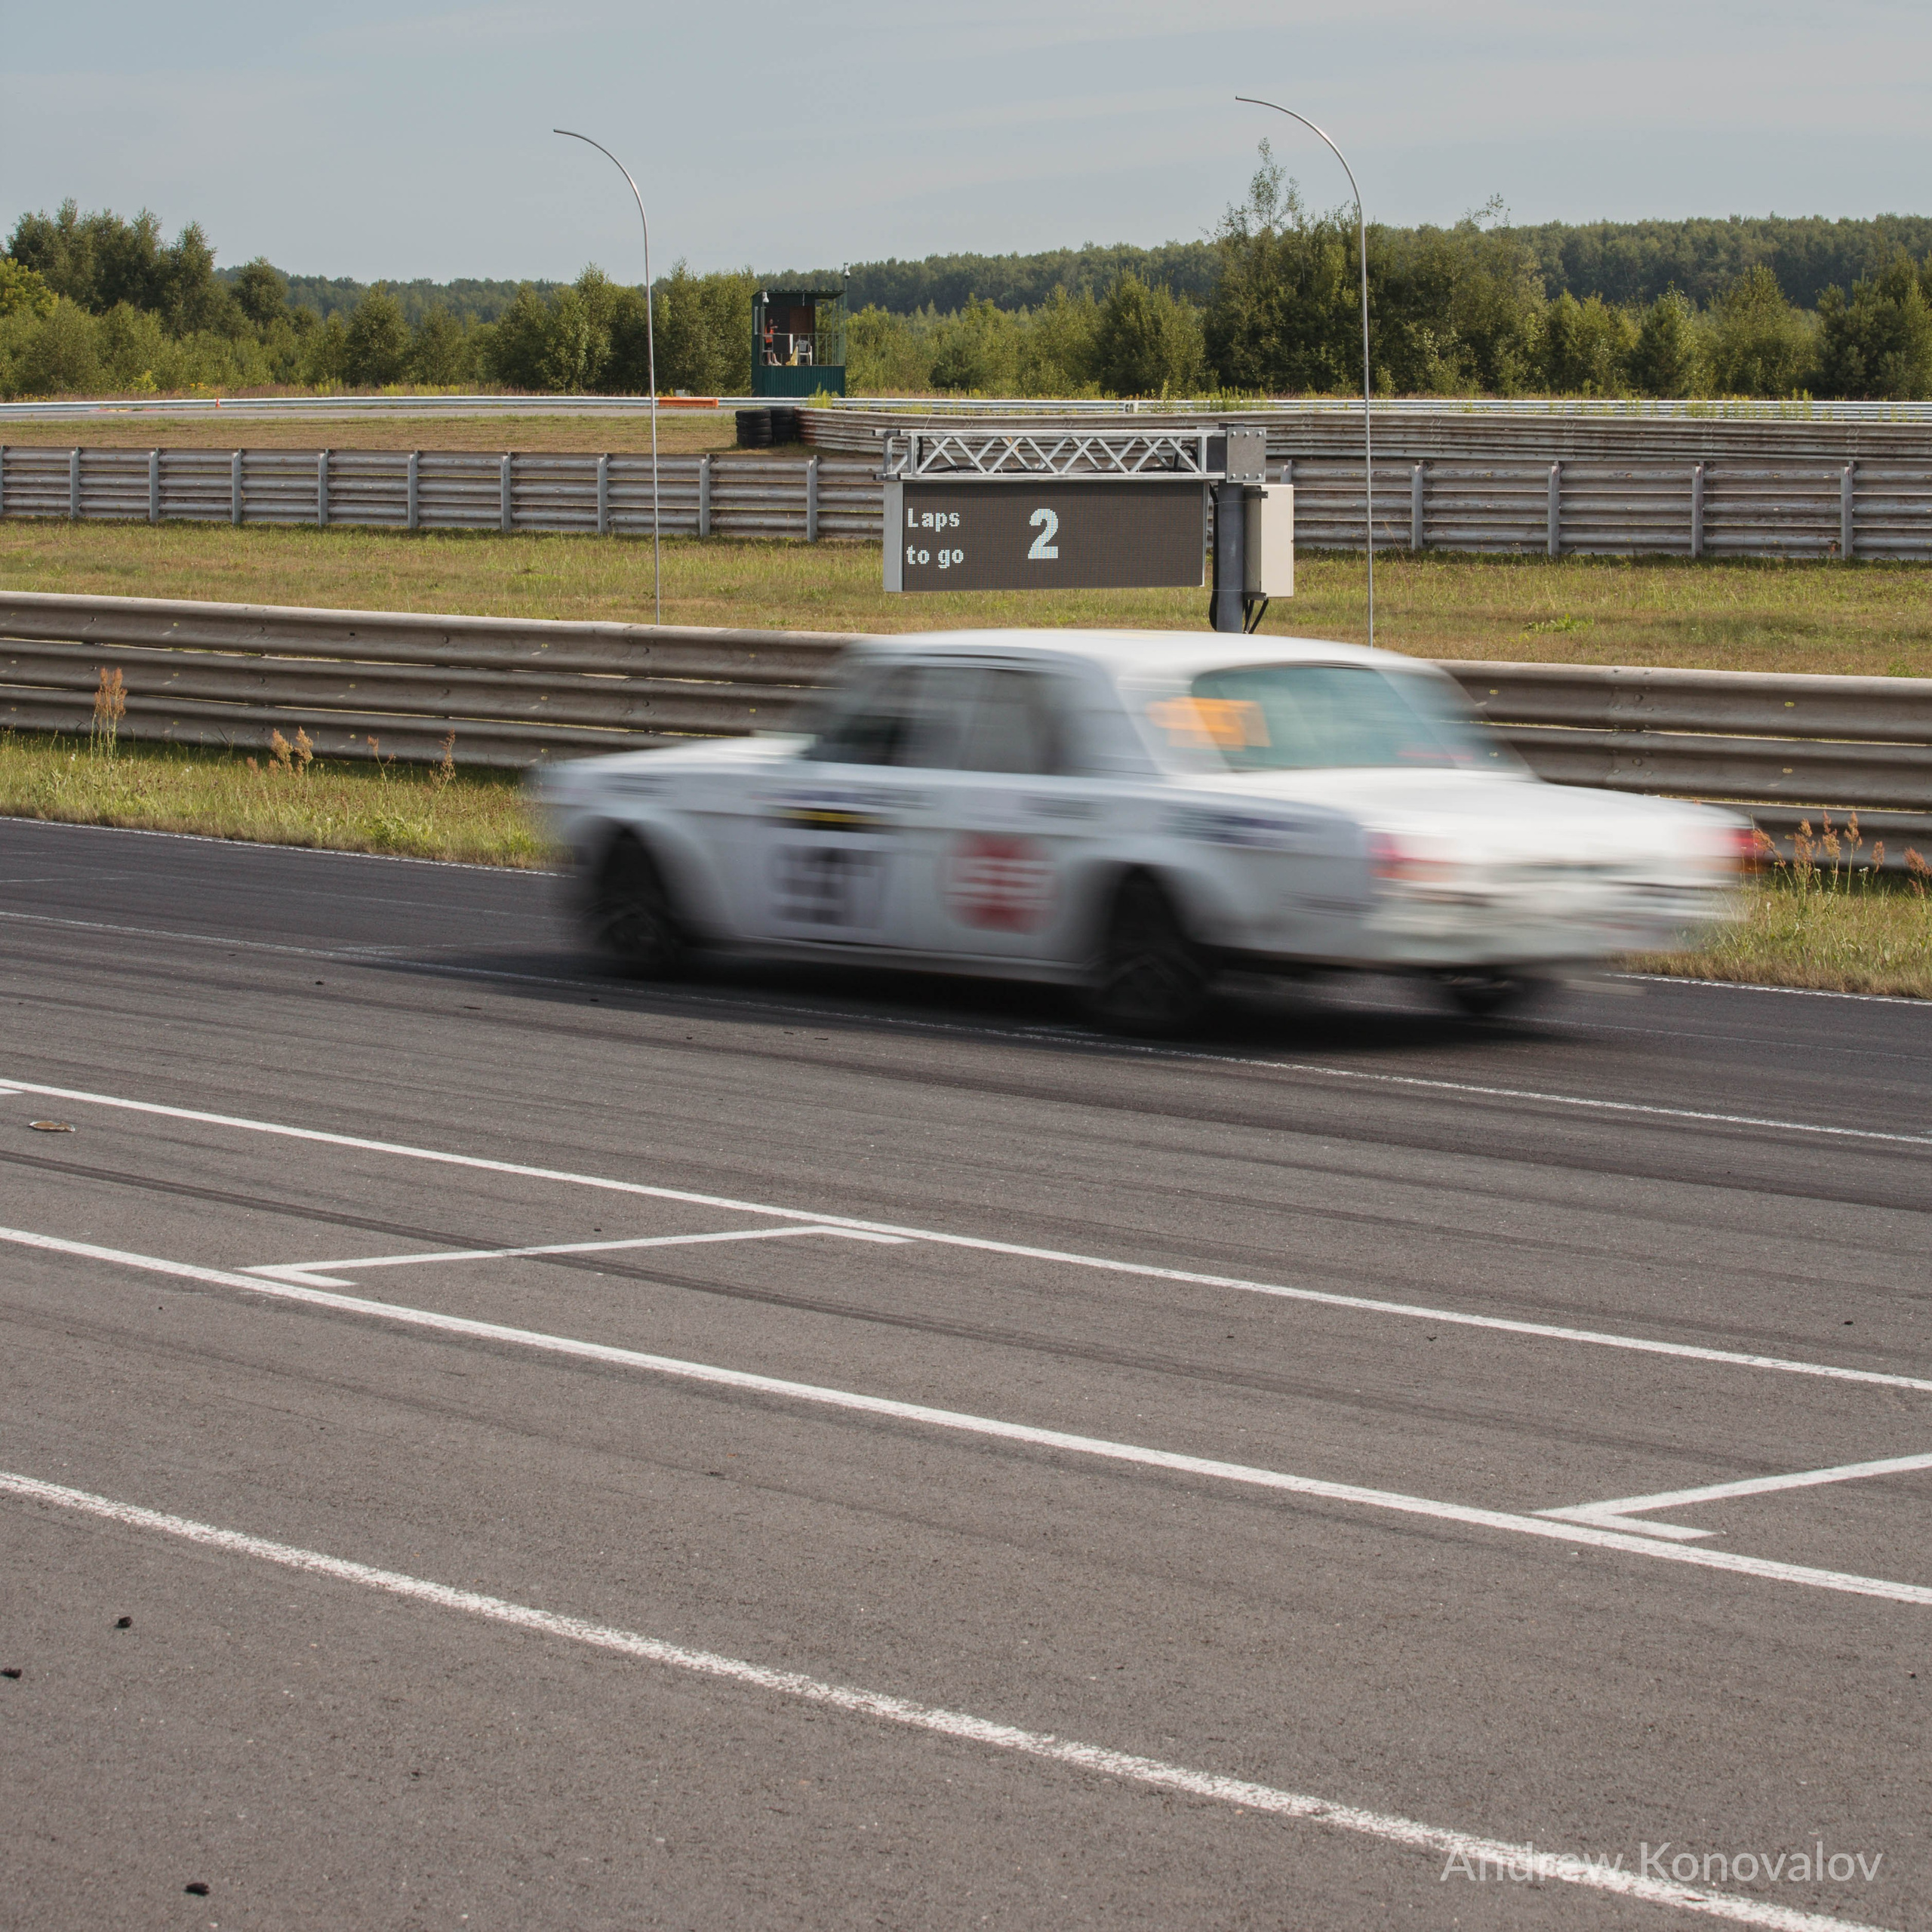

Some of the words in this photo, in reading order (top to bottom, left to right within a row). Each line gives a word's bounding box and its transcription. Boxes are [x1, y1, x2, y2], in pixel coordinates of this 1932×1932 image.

[907, 508, 960, 532] Laps
[1027, 508, 1059, 559] 2
[906, 545, 930, 565] to
[938, 549, 964, 568] go
